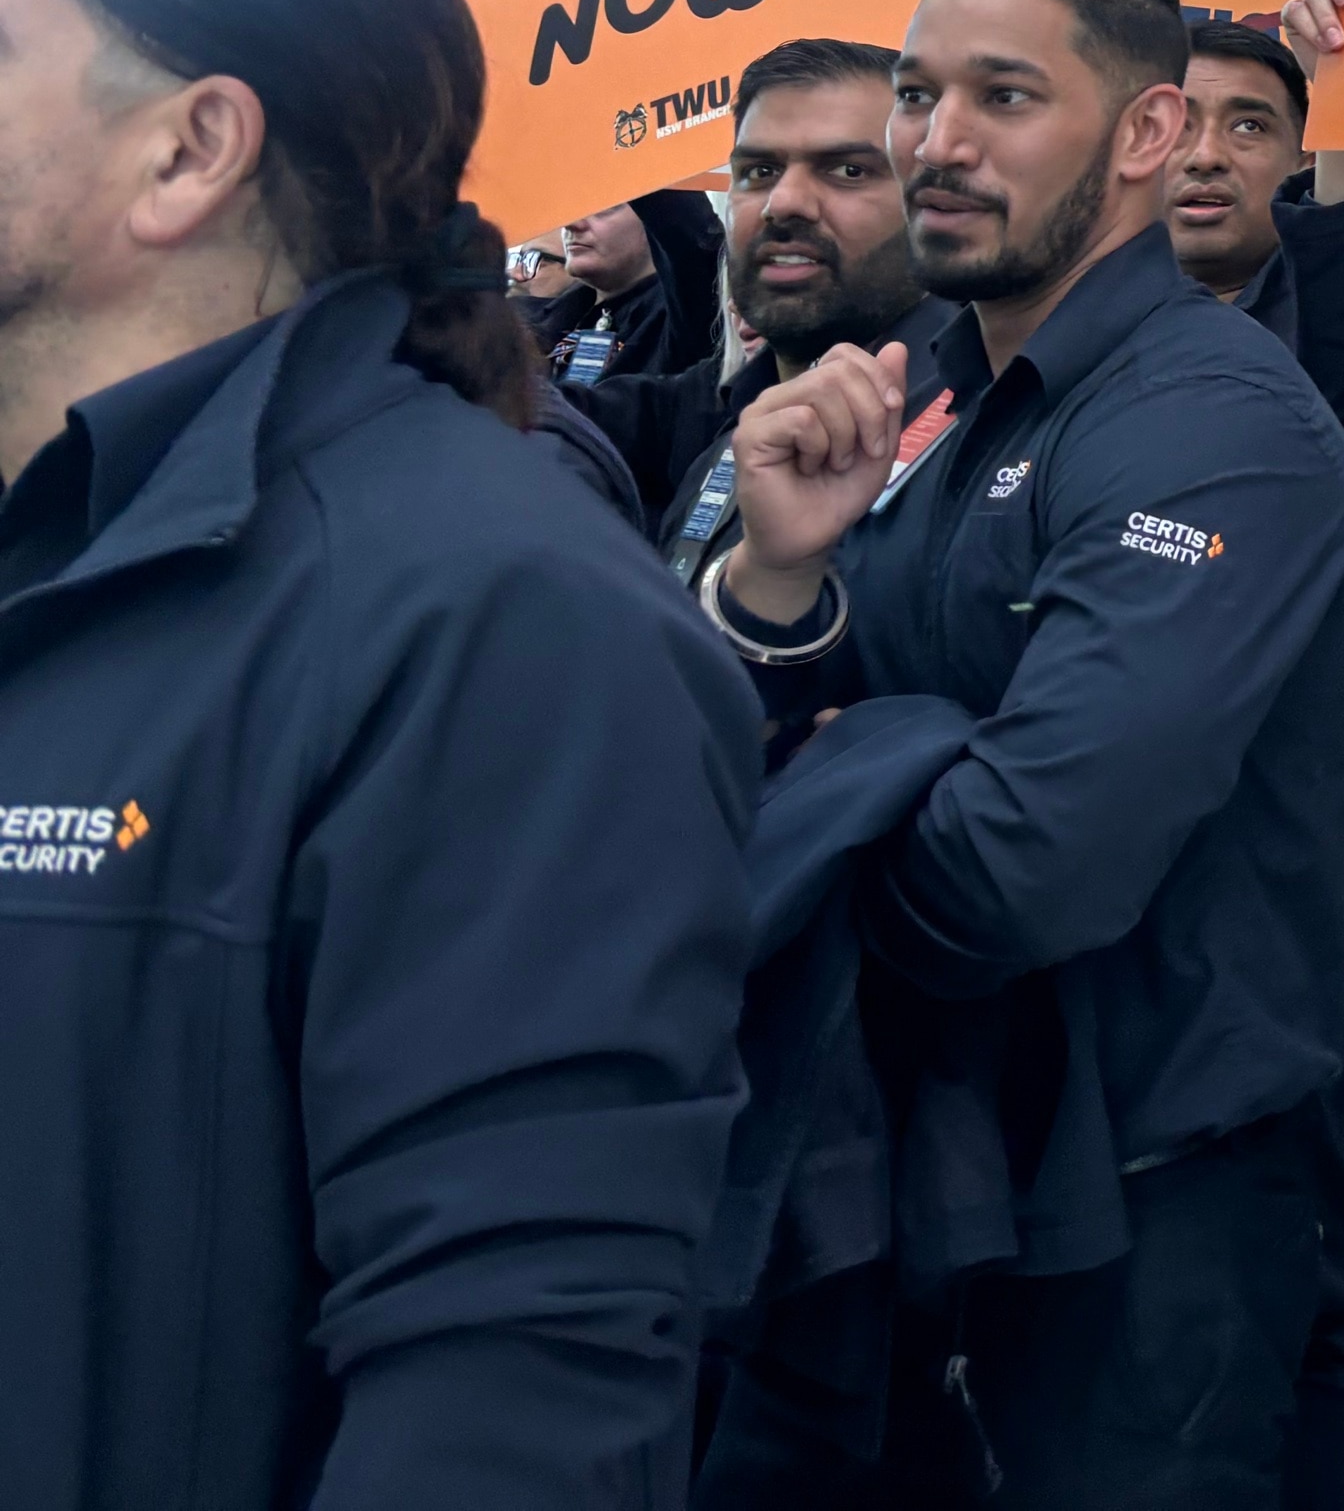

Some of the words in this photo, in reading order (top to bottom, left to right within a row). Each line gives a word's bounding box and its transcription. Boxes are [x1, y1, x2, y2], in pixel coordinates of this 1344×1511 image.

[650, 75, 731, 129] TWU
[656, 124, 682, 139] NSW
[1127, 511, 1208, 549] CERTIS
[1120, 532, 1202, 566] SECURITY
[0, 805, 117, 841] ERTIS
